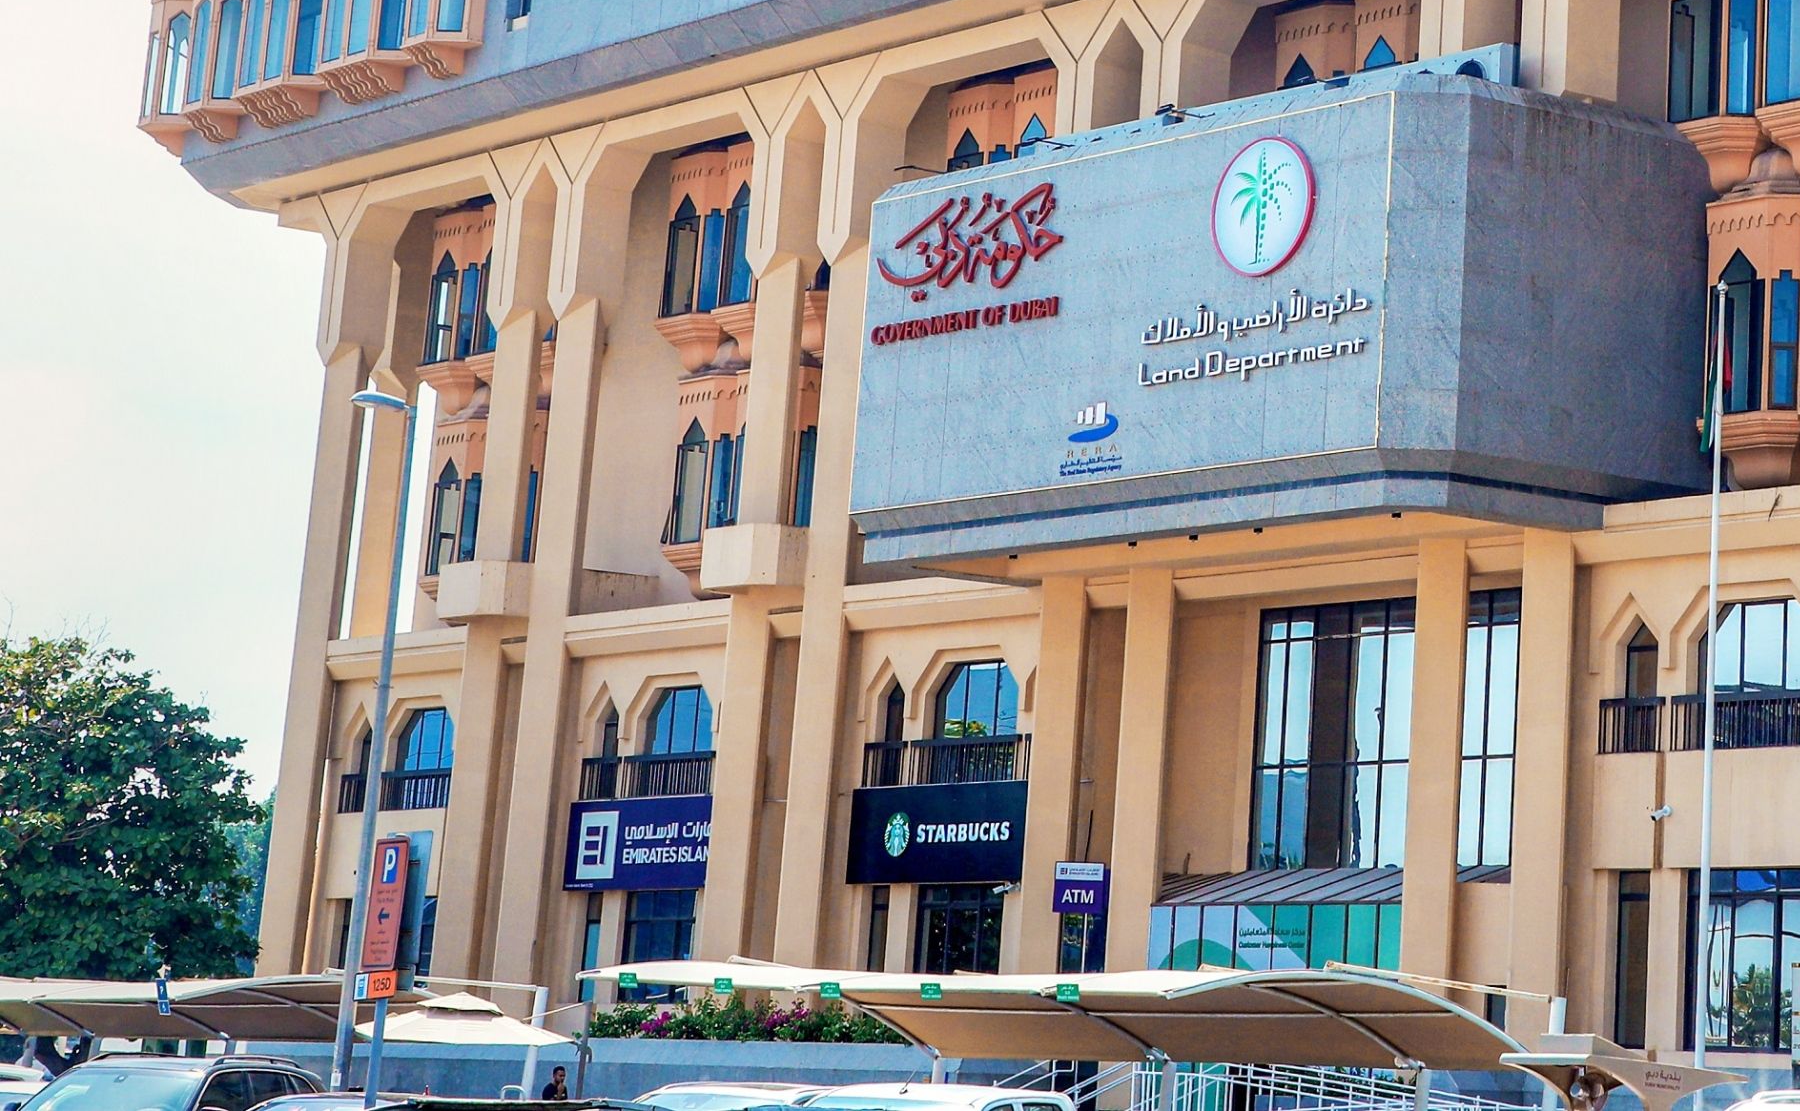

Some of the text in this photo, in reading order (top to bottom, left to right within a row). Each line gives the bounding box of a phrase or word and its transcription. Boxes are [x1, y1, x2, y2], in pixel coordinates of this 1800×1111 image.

[871, 296, 1060, 346] GOVERNMENT OF DUBAI
[1232, 289, 1308, 338] الأراضي
[1311, 288, 1369, 324] دائرة
[1138, 336, 1367, 386] Land Department
[916, 821, 1010, 843] STARBUCKS
[382, 848, 396, 883] P
[622, 846, 677, 864] EMIRATES
[1061, 889, 1094, 904] ATM
[373, 978, 391, 992] 125D
